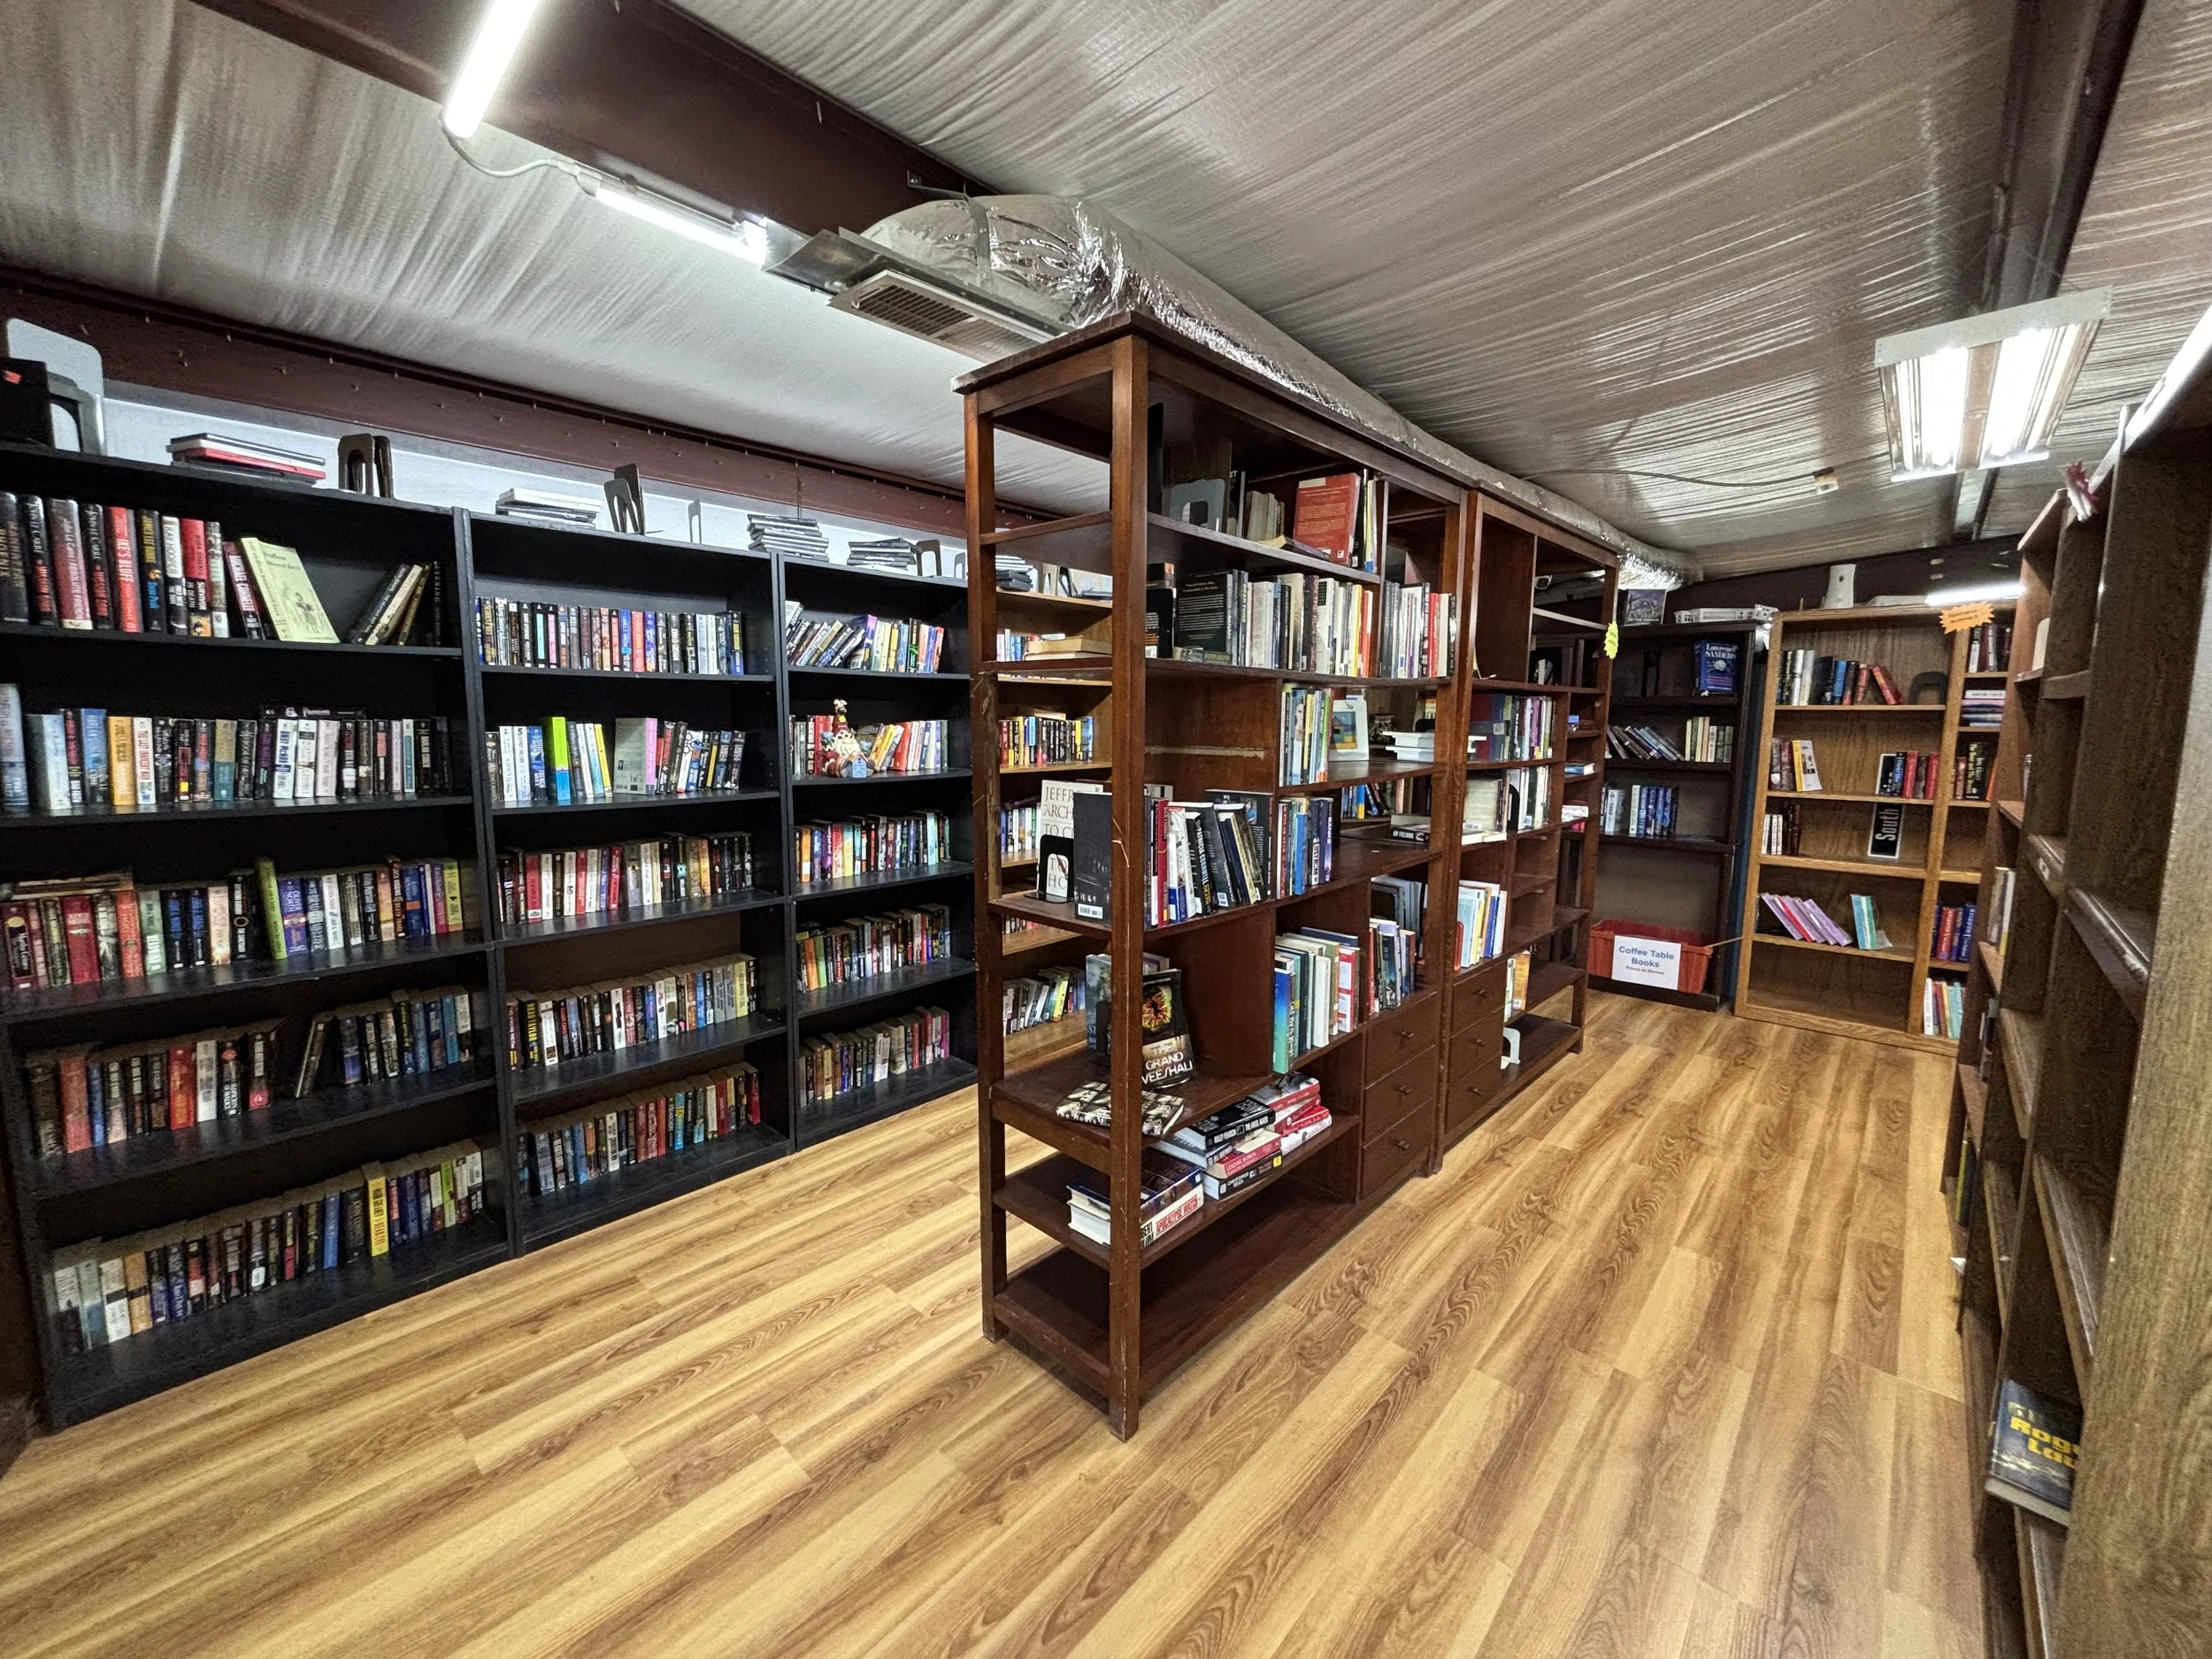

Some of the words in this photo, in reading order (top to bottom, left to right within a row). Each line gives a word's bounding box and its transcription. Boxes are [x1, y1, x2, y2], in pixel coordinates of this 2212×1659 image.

[165, 526, 175, 543] KAY
[118, 538, 132, 557] IKE'S
[166, 542, 178, 574] HOOPER
[119, 559, 134, 582] BLUFF
[228, 555, 247, 582] MICHAEL
[196, 580, 207, 611] SURVIVOR
[235, 582, 256, 611] CONNELLY
[1313, 579, 1318, 594] ON
[1705, 650, 1737, 661] SANDERS
[1874, 808, 1901, 841] South
[1196, 827, 1207, 855] PATRICIA
[1199, 855, 1210, 885] CORNWELL
[1619, 946, 1647, 956] Coffee
[1649, 949, 1675, 960] Table
[1632, 957, 1661, 968] Books
[1145, 1051, 1184, 1071] GRAND
[1153, 1044, 1173, 1056] THE
[1156, 1206, 1182, 1234] APOCALYPSE
[2010, 1416, 2081, 1455] ROG
